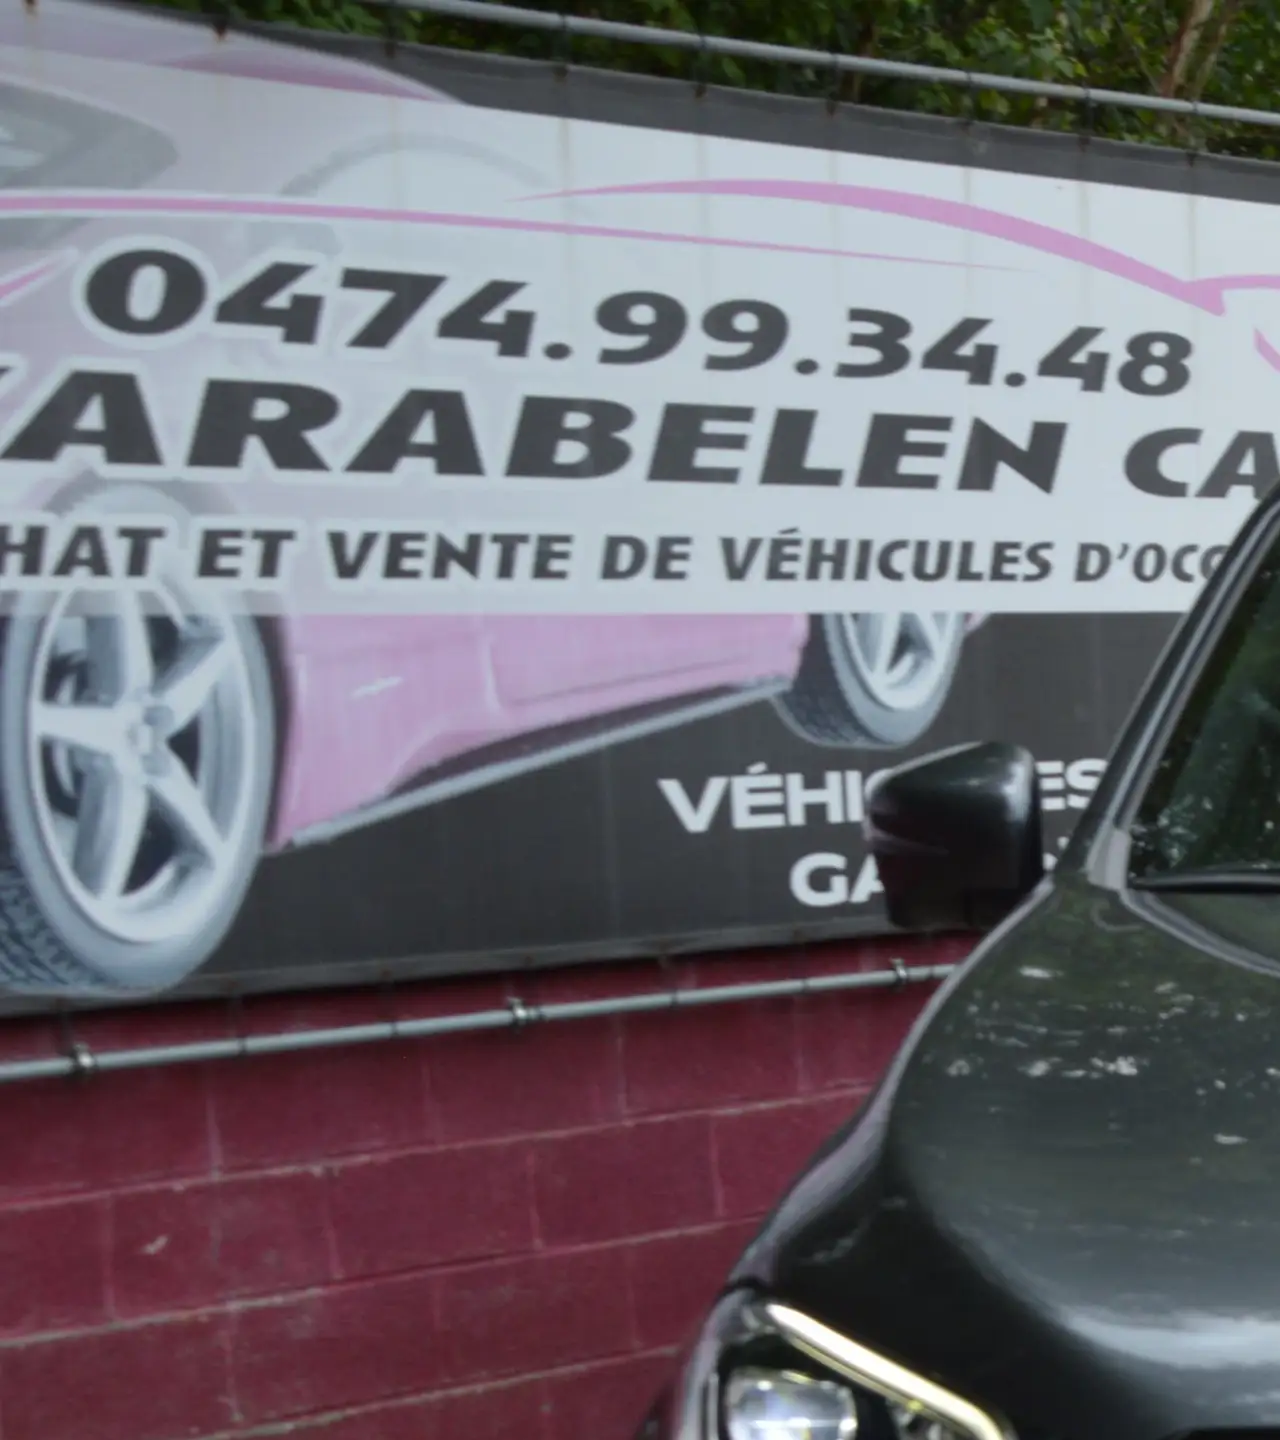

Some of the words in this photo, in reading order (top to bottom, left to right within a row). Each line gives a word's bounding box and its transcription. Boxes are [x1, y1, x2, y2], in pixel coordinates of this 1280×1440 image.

[85, 248, 1192, 397] 0474.99.34.48
[0, 366, 1068, 494] ARABELEN
[197, 529, 296, 578] ET
[328, 531, 573, 580] VENTE
[601, 535, 692, 580] DE
[721, 528, 1054, 582] VÉHICULES
